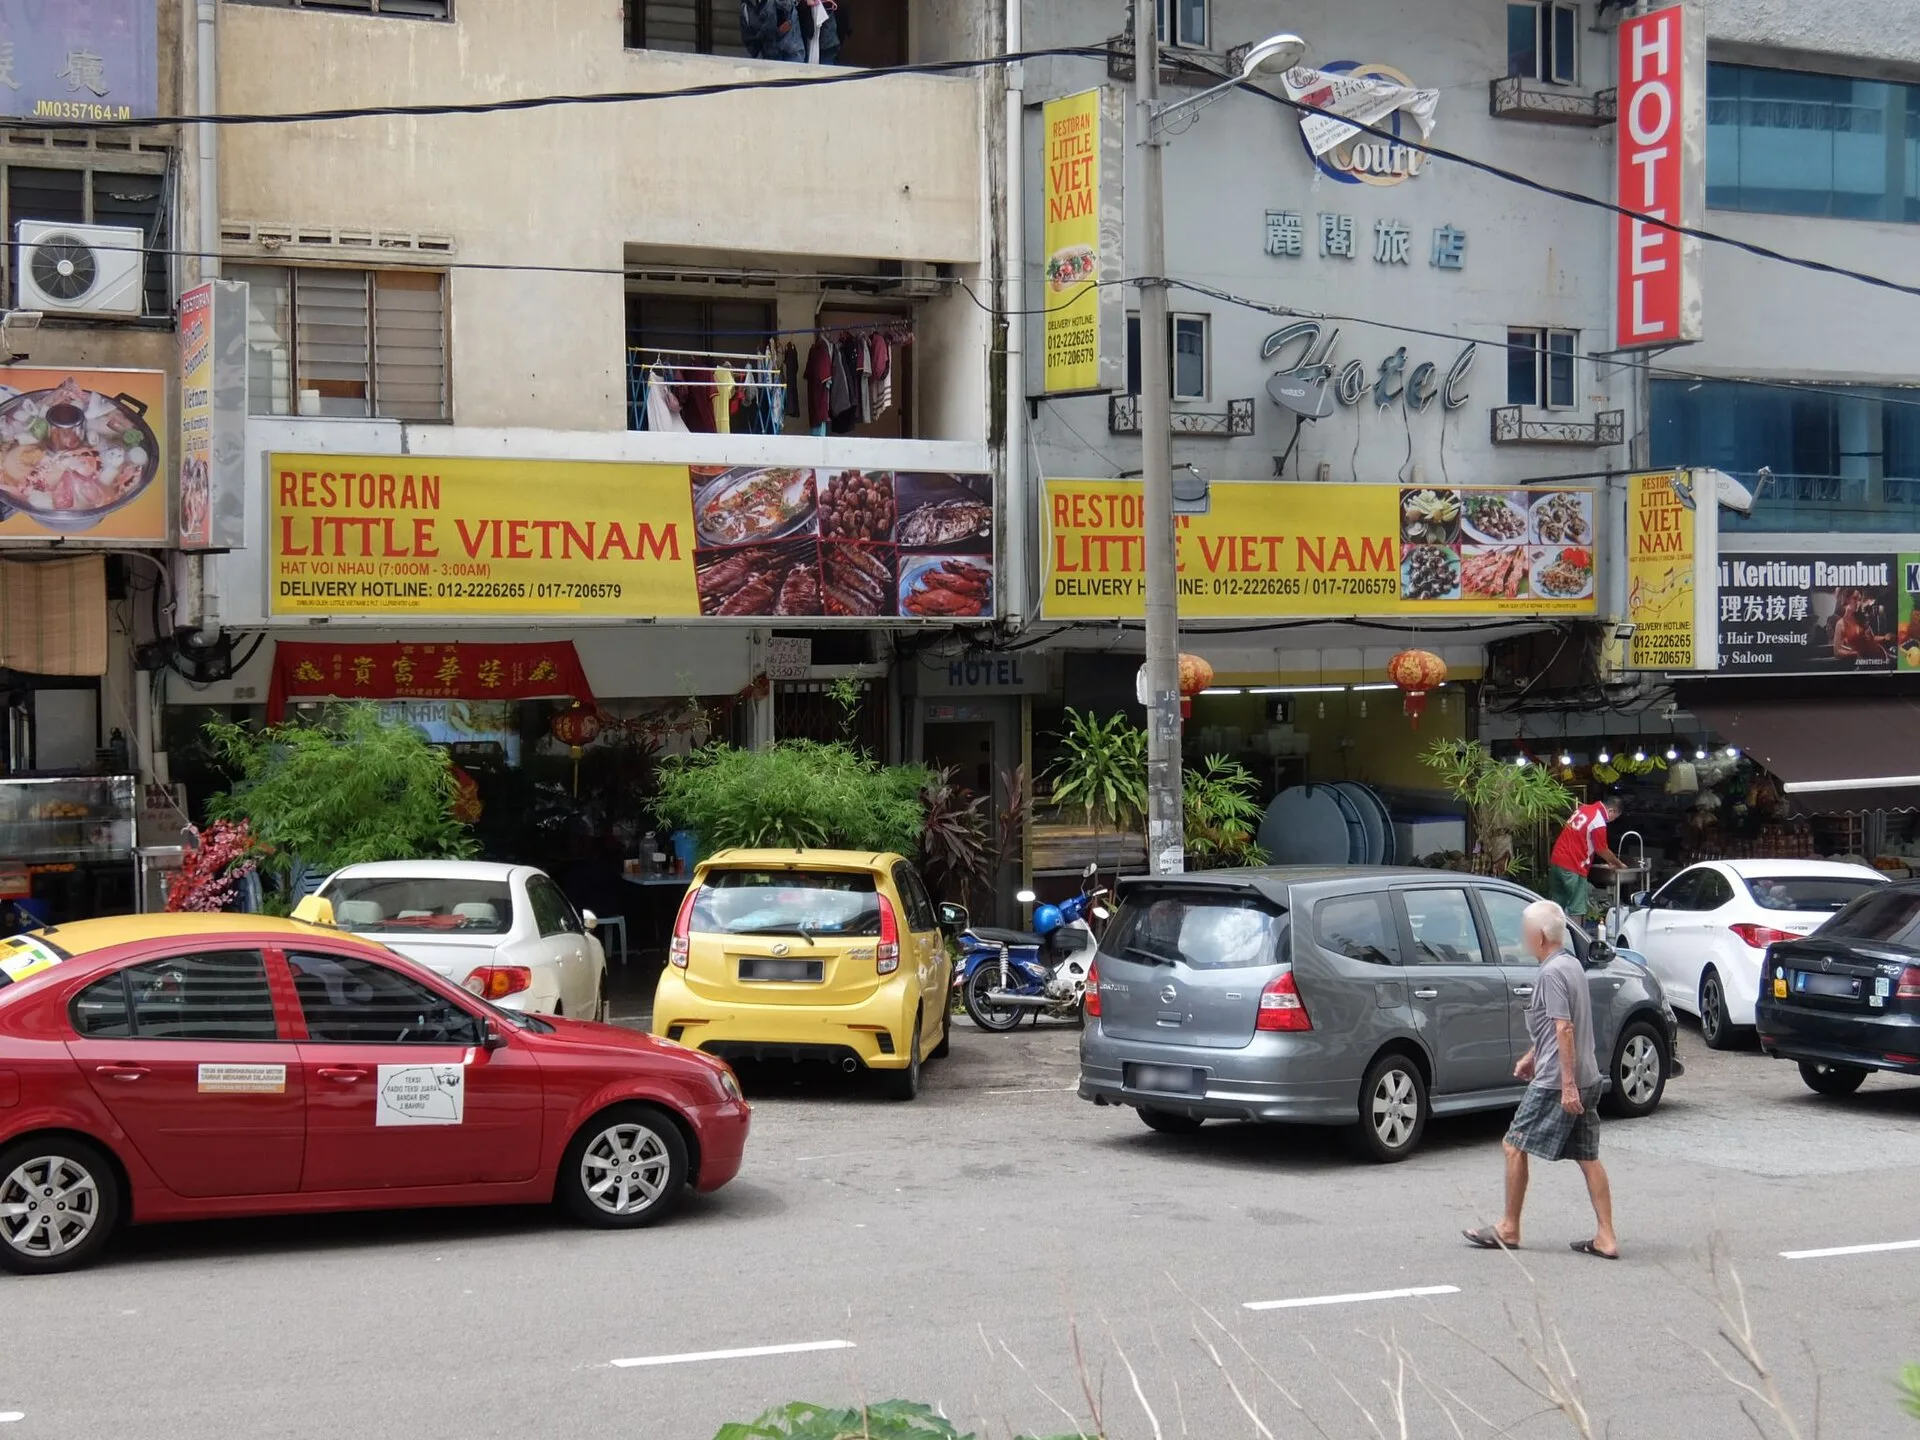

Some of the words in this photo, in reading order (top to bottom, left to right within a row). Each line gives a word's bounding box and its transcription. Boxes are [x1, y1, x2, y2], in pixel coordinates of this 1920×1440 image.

[33, 100, 130, 120] JM0357164-M
[1053, 111, 1091, 137] RESTORAN
[1051, 132, 1092, 162] LITTLE
[1050, 156, 1094, 195] VIET
[1629, 18, 1671, 336] HOTEL
[1049, 189, 1094, 224] NAM
[1047, 318, 1071, 331] DELIVERY
[1047, 328, 1094, 350] 012-2226265
[1047, 348, 1094, 369] 017-7206579
[1262, 321, 1477, 410] Hotel
[279, 471, 440, 510] RESTORAN
[1642, 476, 1674, 490] RESTOR
[1054, 493, 1190, 529] RESTO
[1639, 508, 1683, 533] VIET
[280, 516, 440, 558] LITTLE
[454, 519, 682, 562] VIETNAM
[1638, 532, 1683, 554] NAM
[1197, 536, 1284, 573] VIET
[1295, 536, 1396, 573] NAM
[280, 562, 306, 575] HAT
[310, 563, 335, 575] VOI
[337, 563, 375, 576] NHAU
[440, 563, 491, 578] 3:00AM)
[1733, 561, 1810, 590] Keriting
[1815, 561, 1888, 587] Rambut
[280, 581, 357, 597] DELIVERY
[361, 582, 433, 598] HOTLINE:
[437, 583, 525, 598] 012-2226265
[537, 583, 622, 599] 017-7206579
[1055, 578, 1132, 596] DELIVERY
[1138, 579, 1208, 595] HINE:
[1213, 578, 1300, 595] 012-2226265
[1312, 578, 1396, 595] 017-7206579
[1720, 595, 1808, 622] 理发按摩
[1634, 634, 1691, 648] 012-2226265
[1727, 631, 1754, 645] Hair
[1757, 631, 1808, 645] Dressing
[1634, 651, 1691, 665] 017-7206579
[1732, 651, 1773, 664] Saloon
[949, 660, 1023, 686] HOTEL
